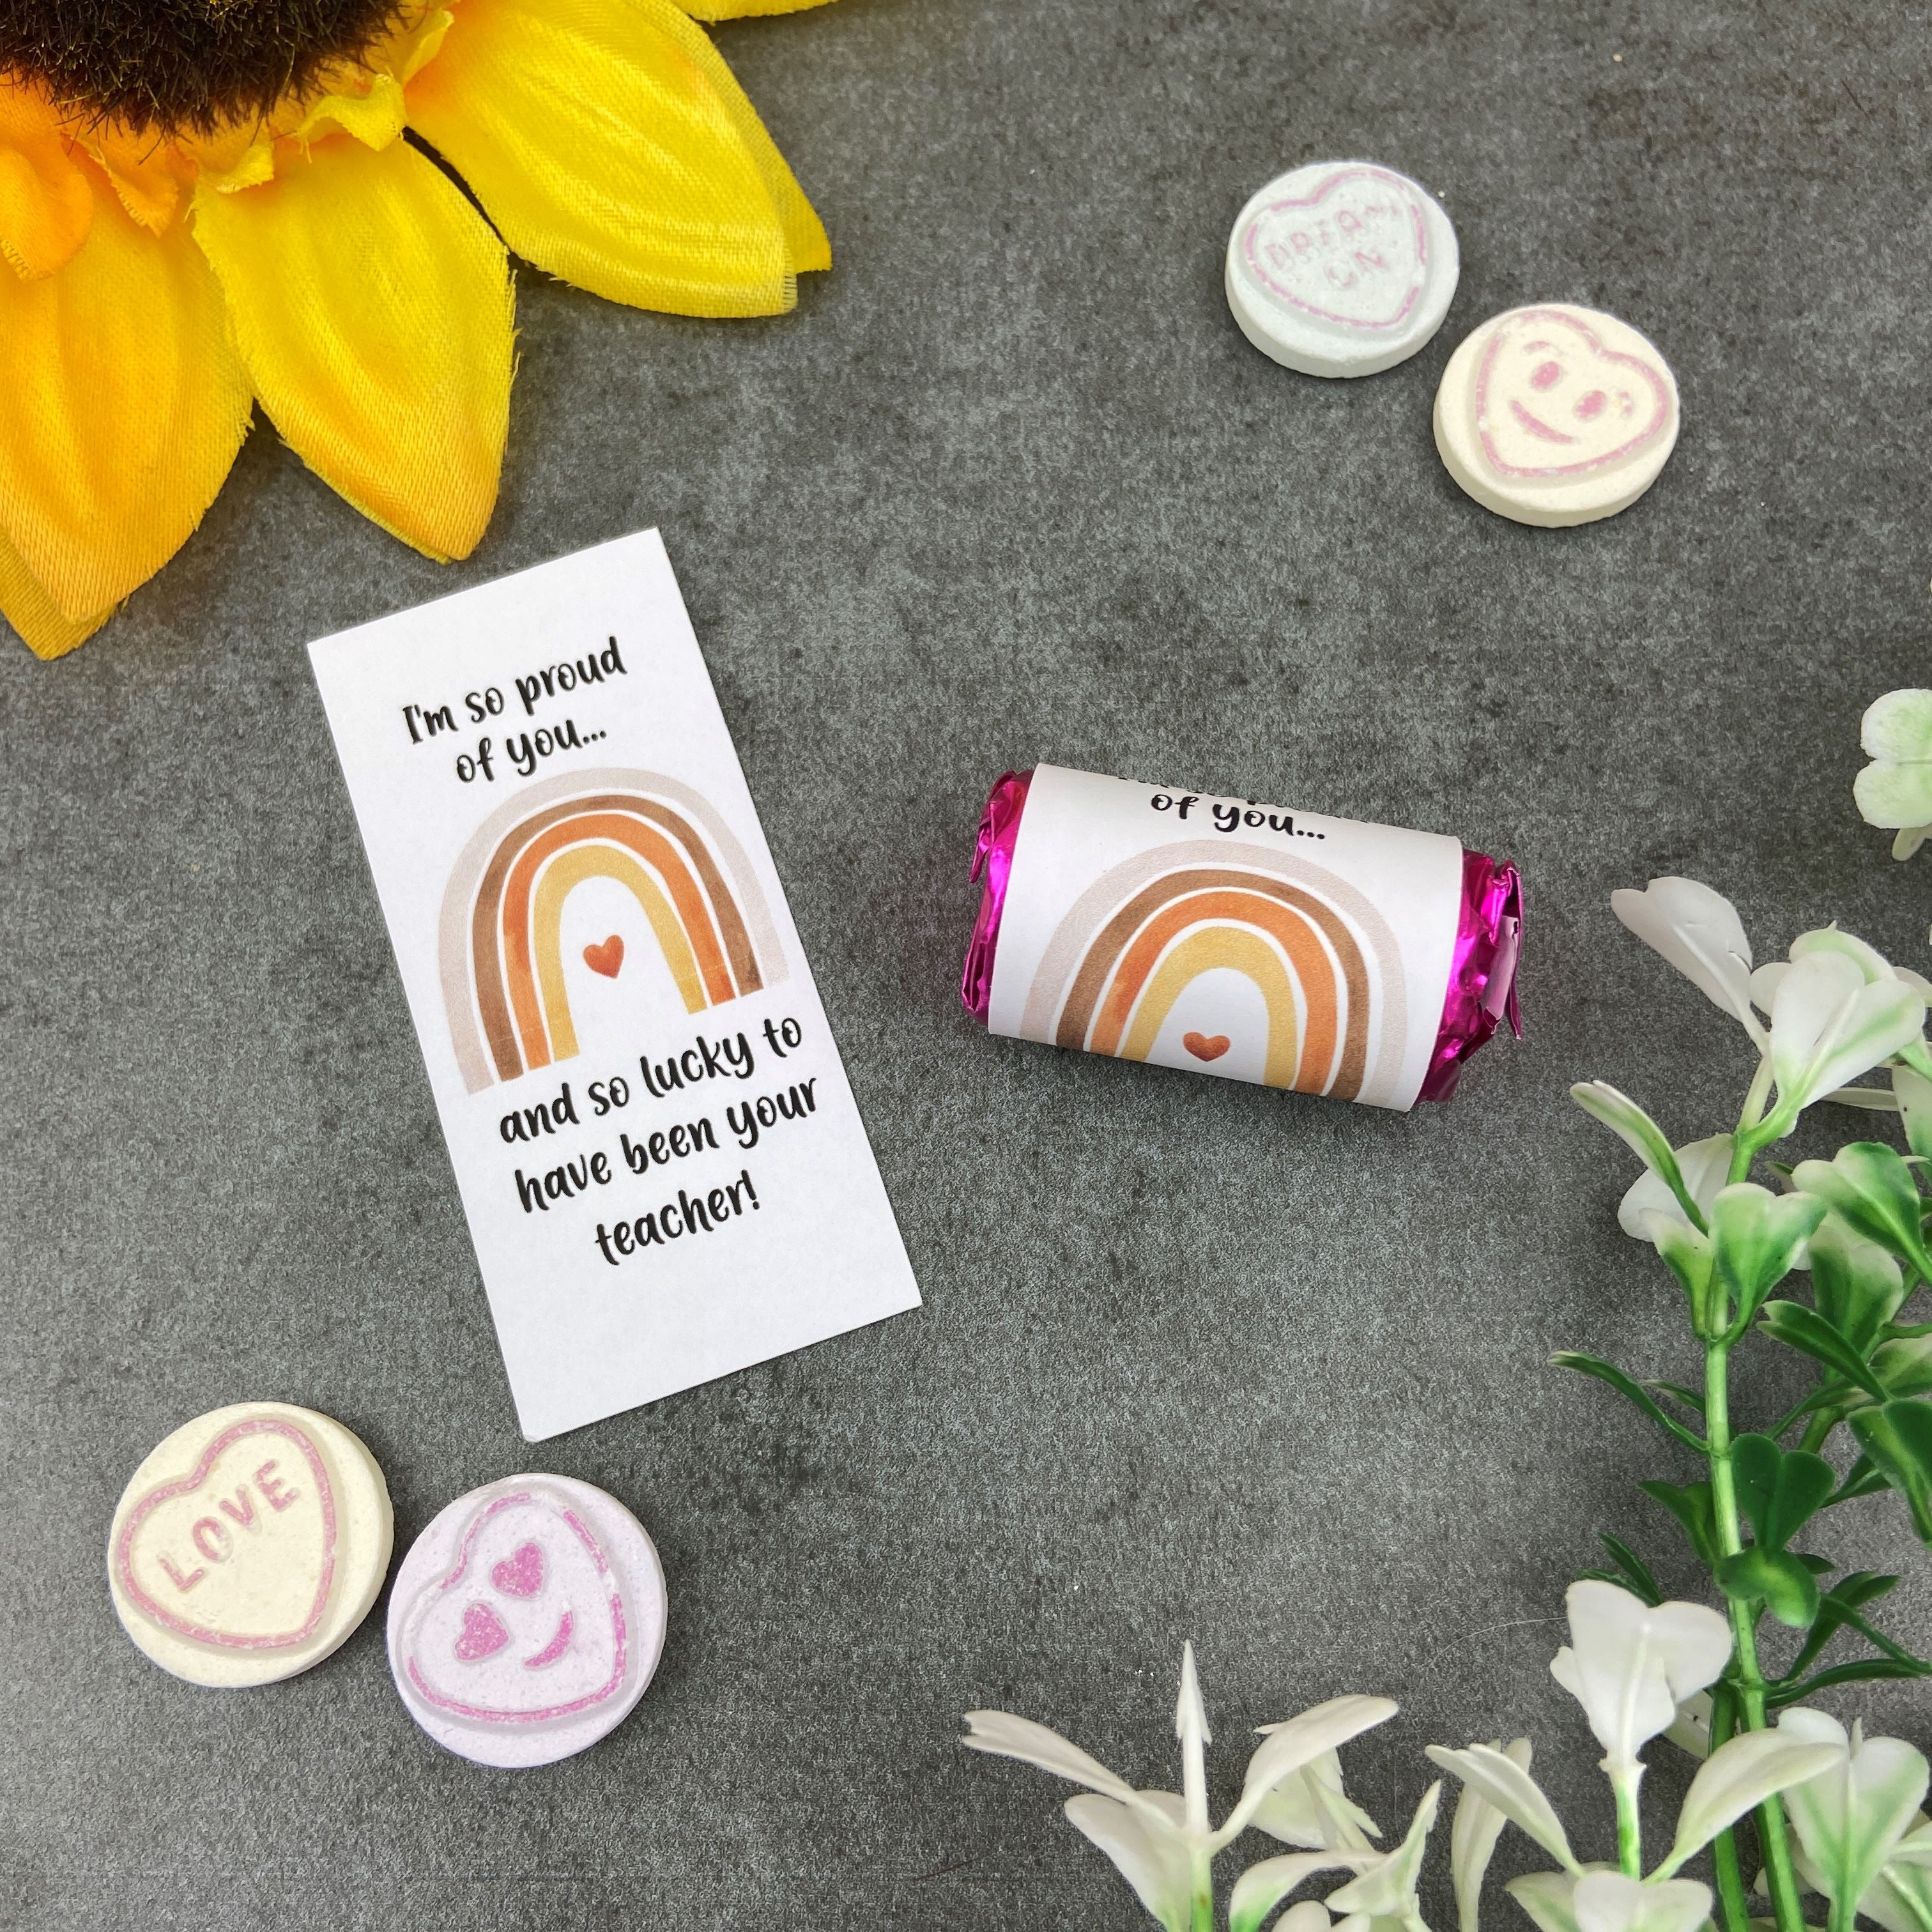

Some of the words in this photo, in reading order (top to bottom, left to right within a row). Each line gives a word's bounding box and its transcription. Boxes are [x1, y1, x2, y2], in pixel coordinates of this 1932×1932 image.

[402, 704, 459, 745] I'm
[465, 687, 505, 723] so
[515, 635, 628, 716] proud
[456, 737, 494, 783] of
[506, 719, 607, 777] you...
[1151, 793, 1199, 820] of
[1212, 803, 1326, 840] you...
[500, 1082, 580, 1144] and
[587, 1076, 630, 1116] so
[640, 1032, 755, 1098] lucky
[762, 1017, 802, 1058] to
[514, 1151, 612, 1213] have
[620, 1117, 720, 1175] been
[726, 1077, 816, 1149] your
[594, 1169, 760, 1266] teacher!
[157, 1459, 299, 1592] LOVE
